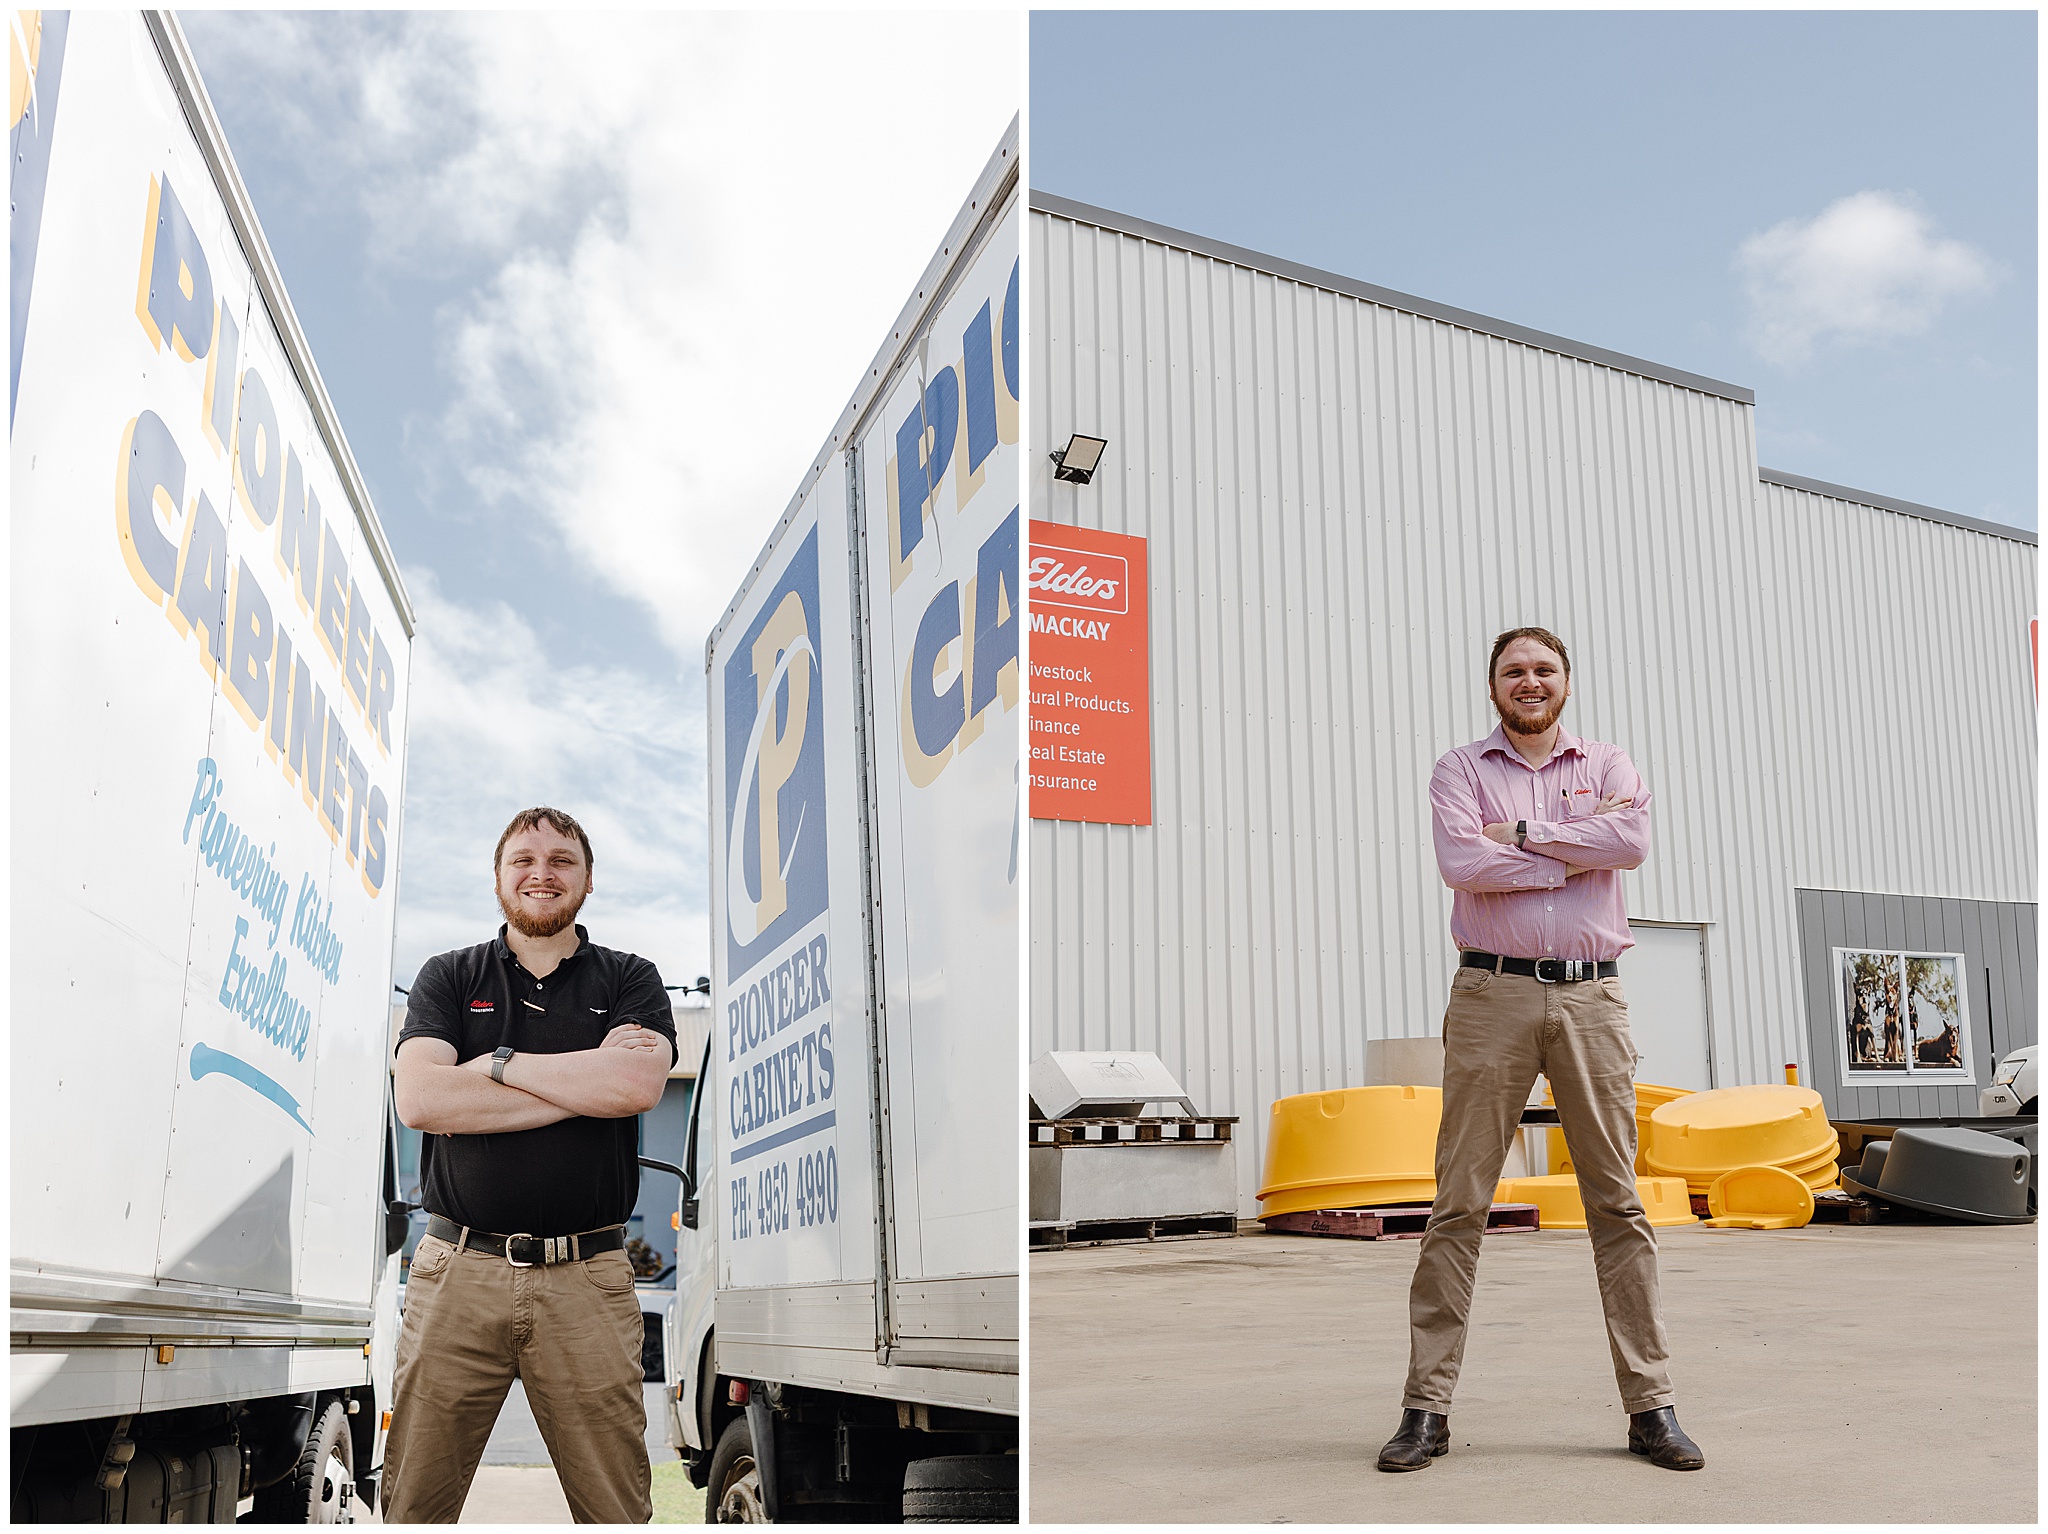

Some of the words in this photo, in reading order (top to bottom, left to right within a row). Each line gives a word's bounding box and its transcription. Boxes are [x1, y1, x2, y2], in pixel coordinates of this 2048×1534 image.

[136, 170, 392, 756] PIONEER
[886, 253, 1020, 594] PI
[1029, 557, 1119, 600] Elders
[1029, 612, 1110, 641] MACKAY
[115, 409, 389, 899] CABINETS
[1029, 690, 1061, 707] ural
[1029, 715, 1081, 735] inance
[1029, 744, 1055, 761] eal
[1059, 746, 1106, 765] Estate
[182, 757, 289, 950] Pioneering
[290, 872, 343, 985] Kitchen
[219, 915, 312, 1062] Excellence
[727, 933, 831, 1063] PIONEER
[730, 1022, 835, 1140] CABINETS
[731, 1175, 752, 1241] PH:
[757, 1161, 789, 1236] 4952
[796, 1145, 838, 1228] 4990
